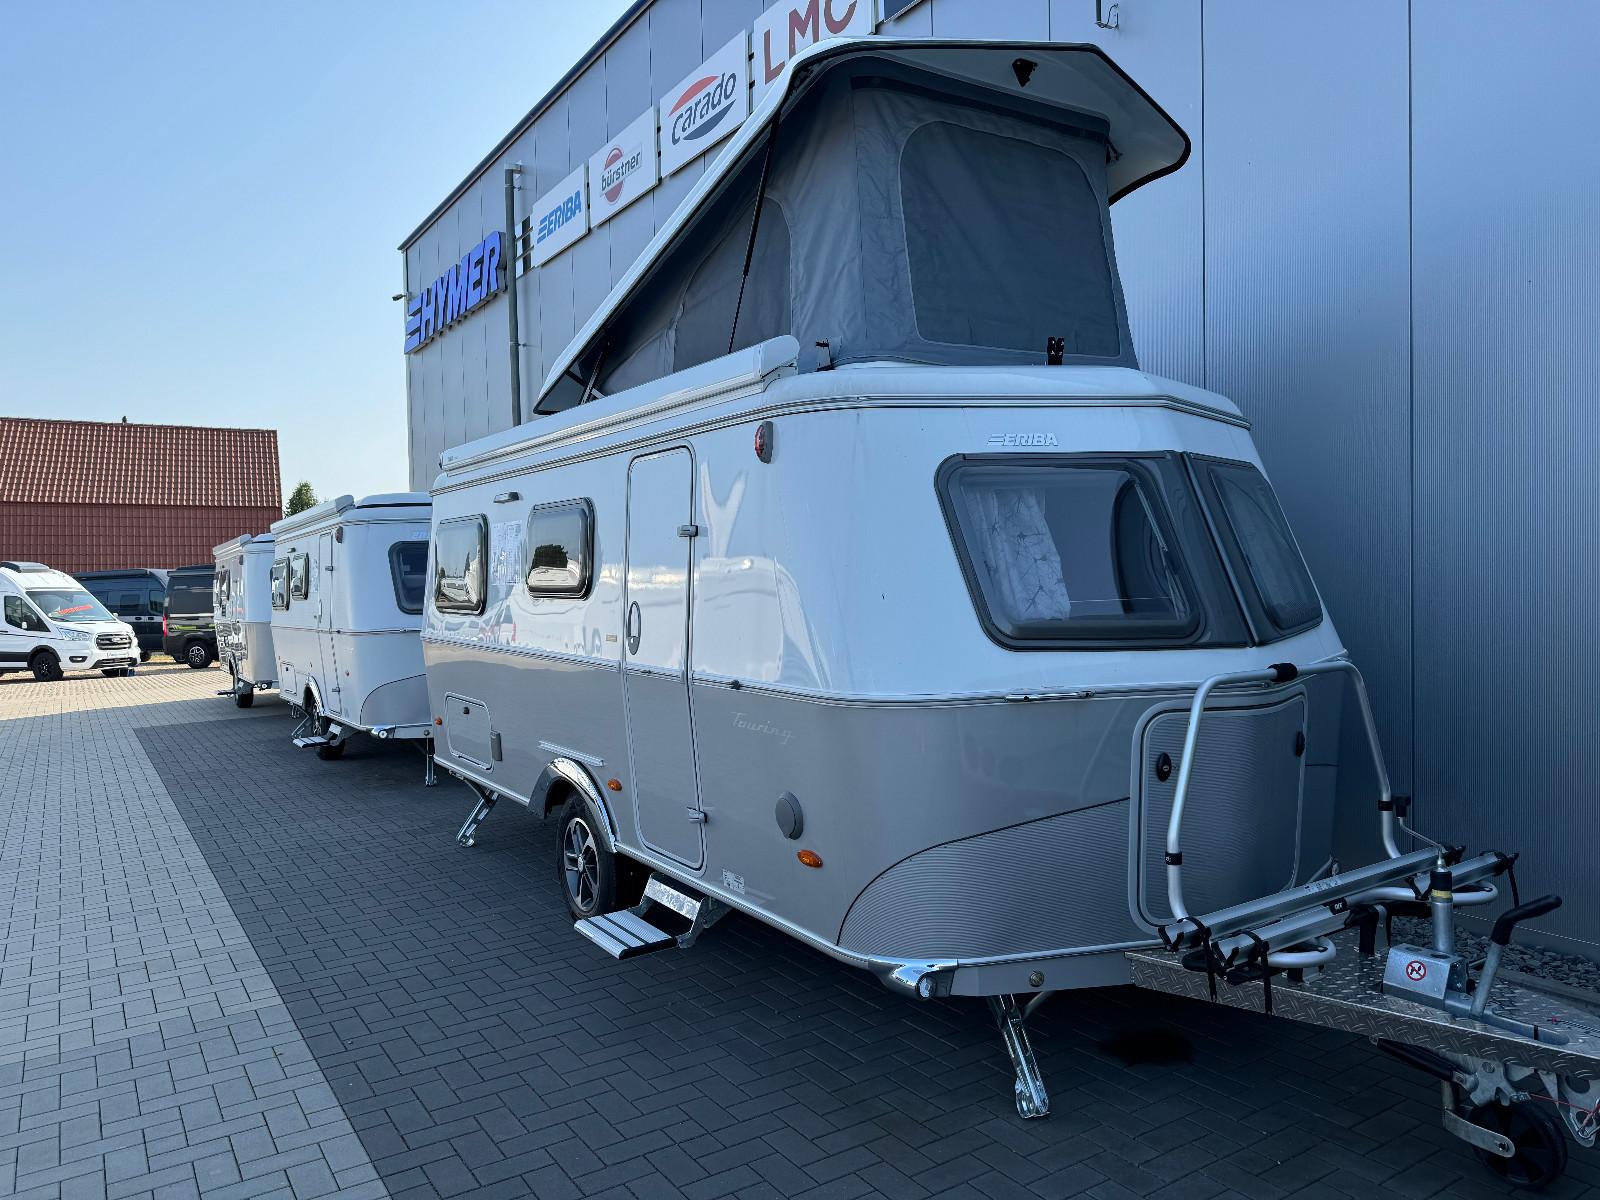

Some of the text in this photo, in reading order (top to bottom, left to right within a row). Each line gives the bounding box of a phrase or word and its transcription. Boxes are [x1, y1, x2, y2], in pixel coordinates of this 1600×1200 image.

[601, 152, 640, 191] bürstner
[546, 190, 582, 237] ERIBA
[419, 231, 500, 343] HYMER
[1003, 433, 1058, 446] ERIBA
[730, 711, 796, 745] Touring
